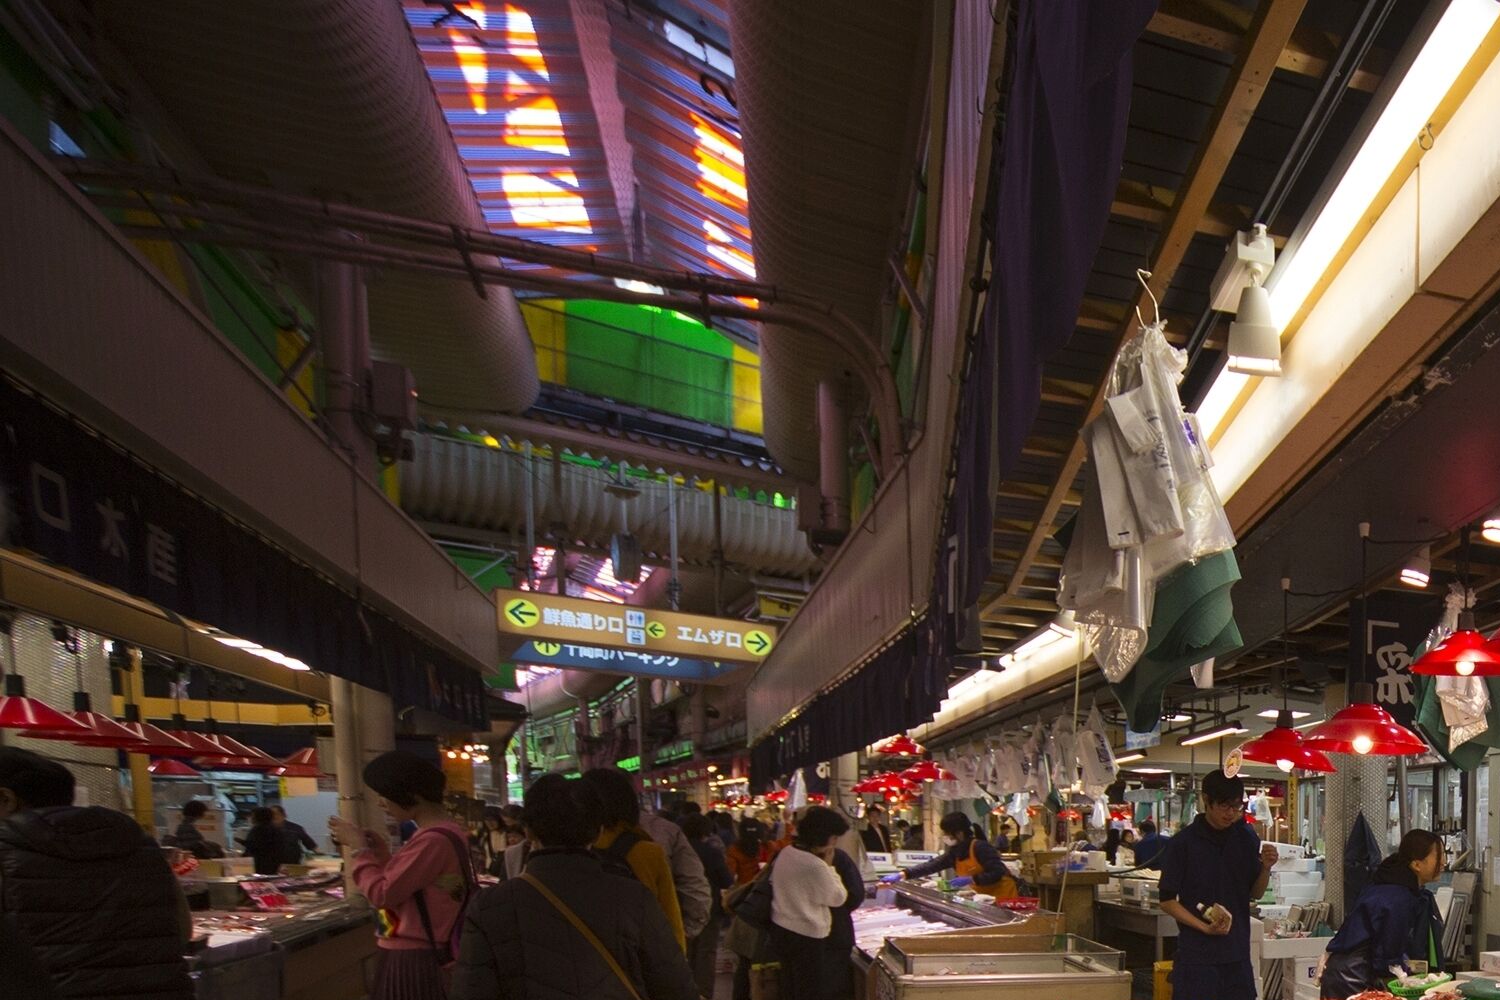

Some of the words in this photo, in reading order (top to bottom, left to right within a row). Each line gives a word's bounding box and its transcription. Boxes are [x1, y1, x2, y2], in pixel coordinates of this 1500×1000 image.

[542, 607, 625, 634] 鮮魚通り口
